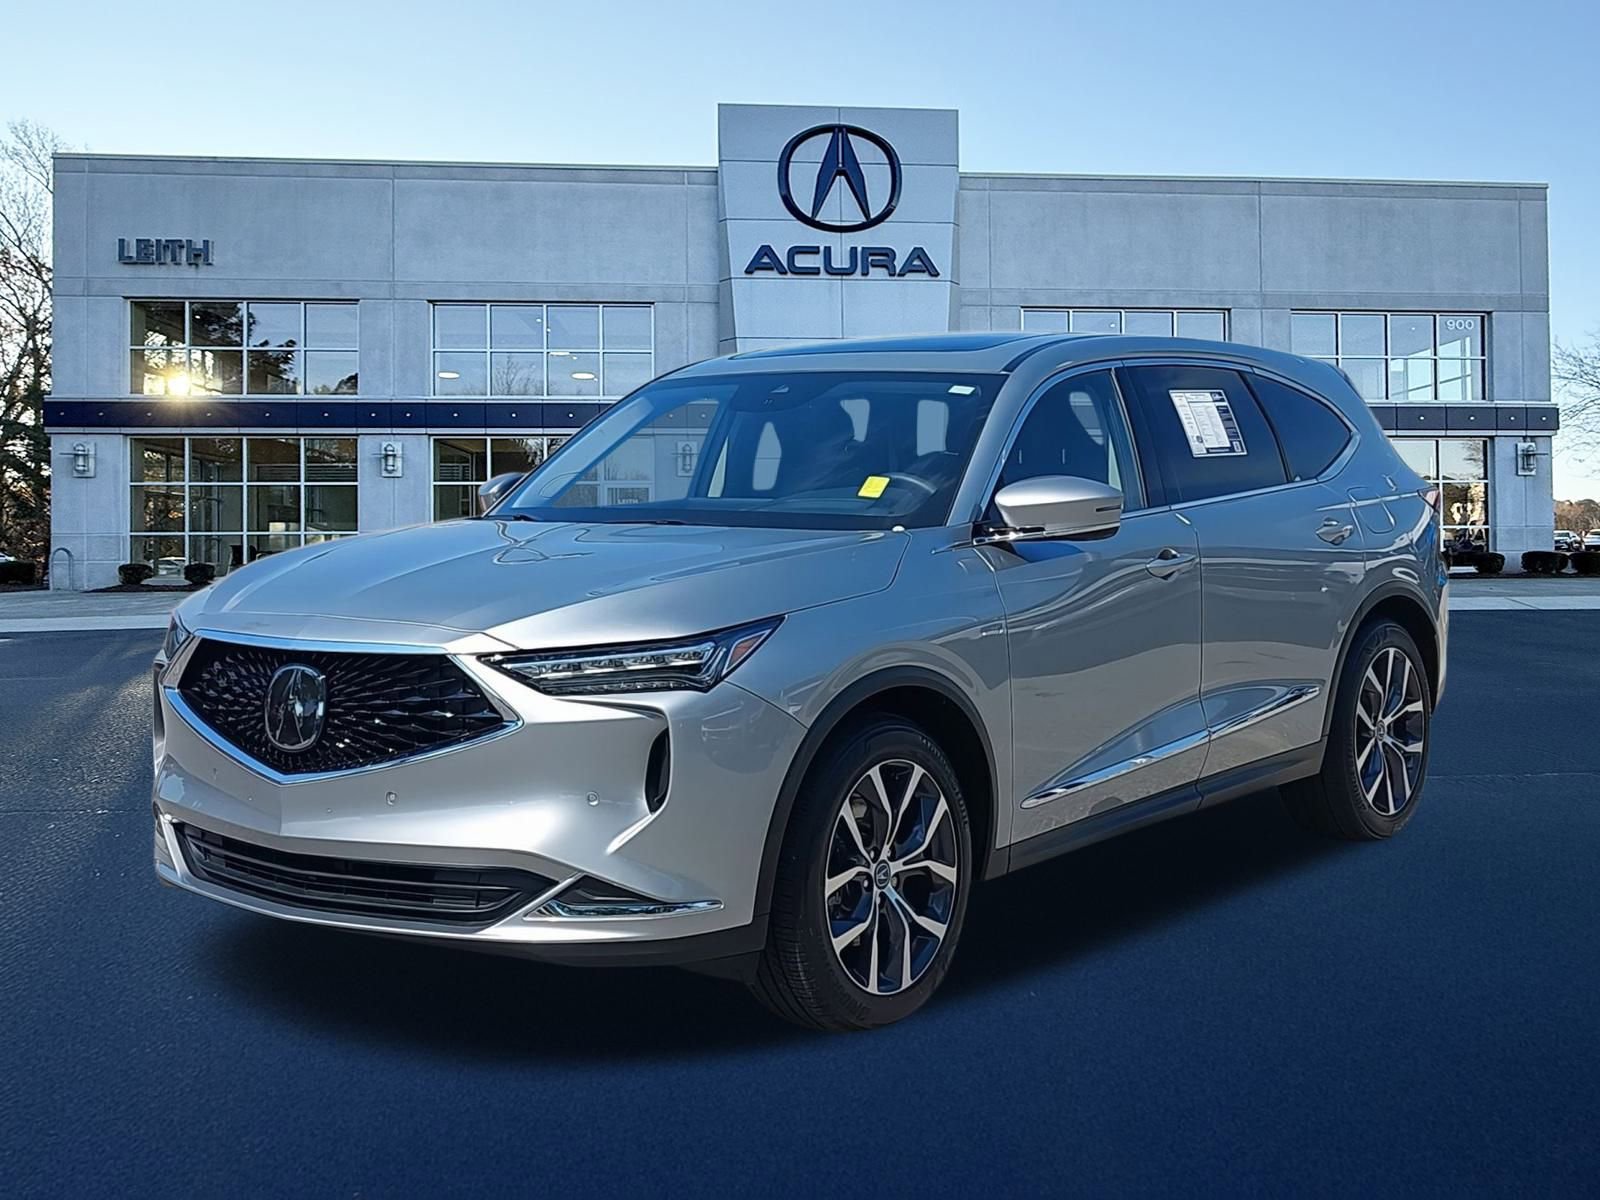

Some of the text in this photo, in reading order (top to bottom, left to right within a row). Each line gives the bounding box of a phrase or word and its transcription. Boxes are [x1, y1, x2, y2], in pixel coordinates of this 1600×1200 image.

[118, 238, 212, 265] LEITH
[744, 244, 940, 277] ACURA
[1446, 319, 1474, 330] 900
